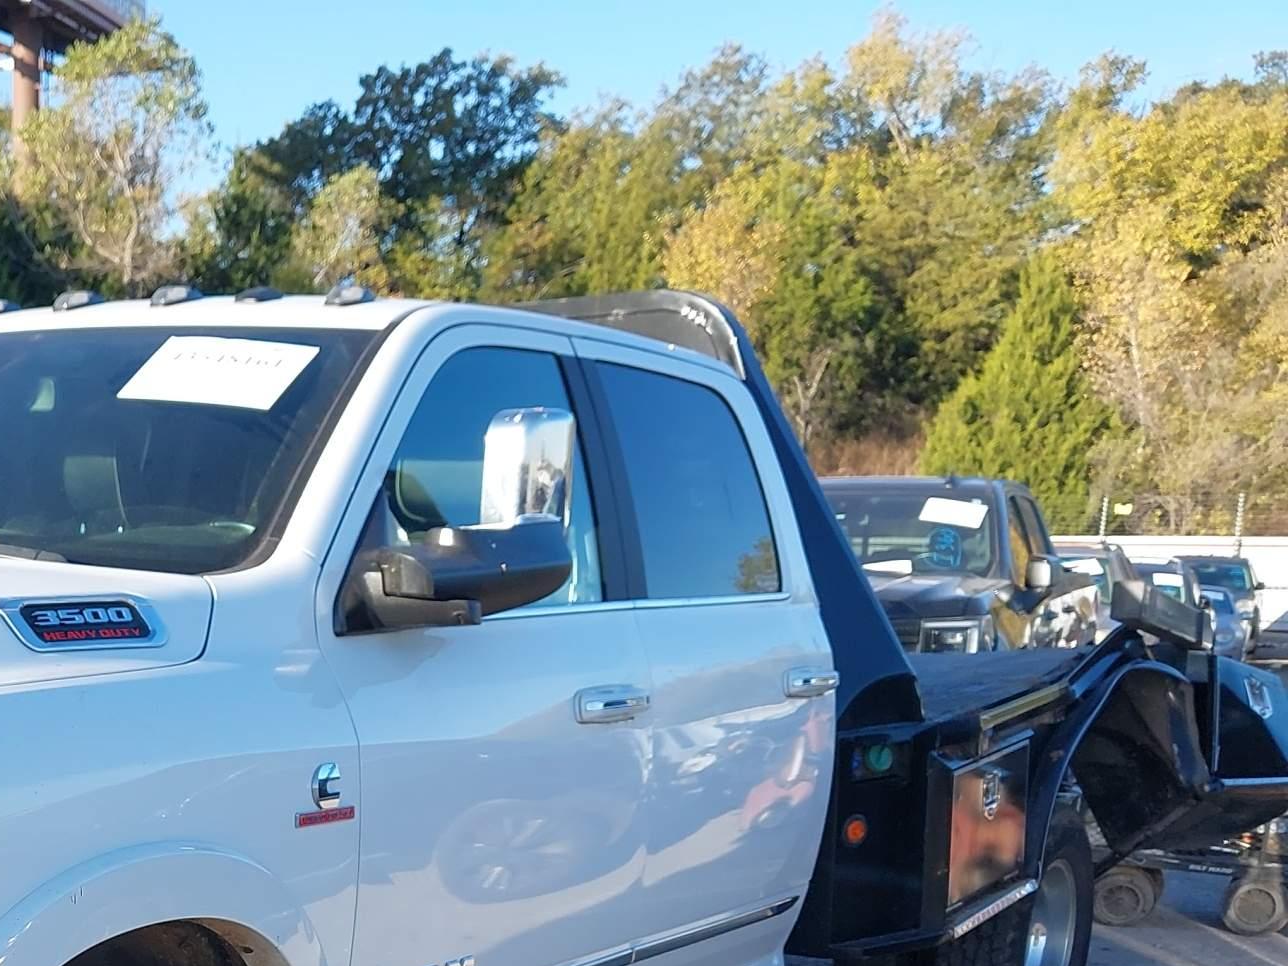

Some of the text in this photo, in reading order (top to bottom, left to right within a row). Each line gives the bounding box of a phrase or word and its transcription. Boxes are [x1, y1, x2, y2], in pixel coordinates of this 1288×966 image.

[32, 607, 133, 626] 3500
[43, 627, 140, 641] HEAVY DUTY
